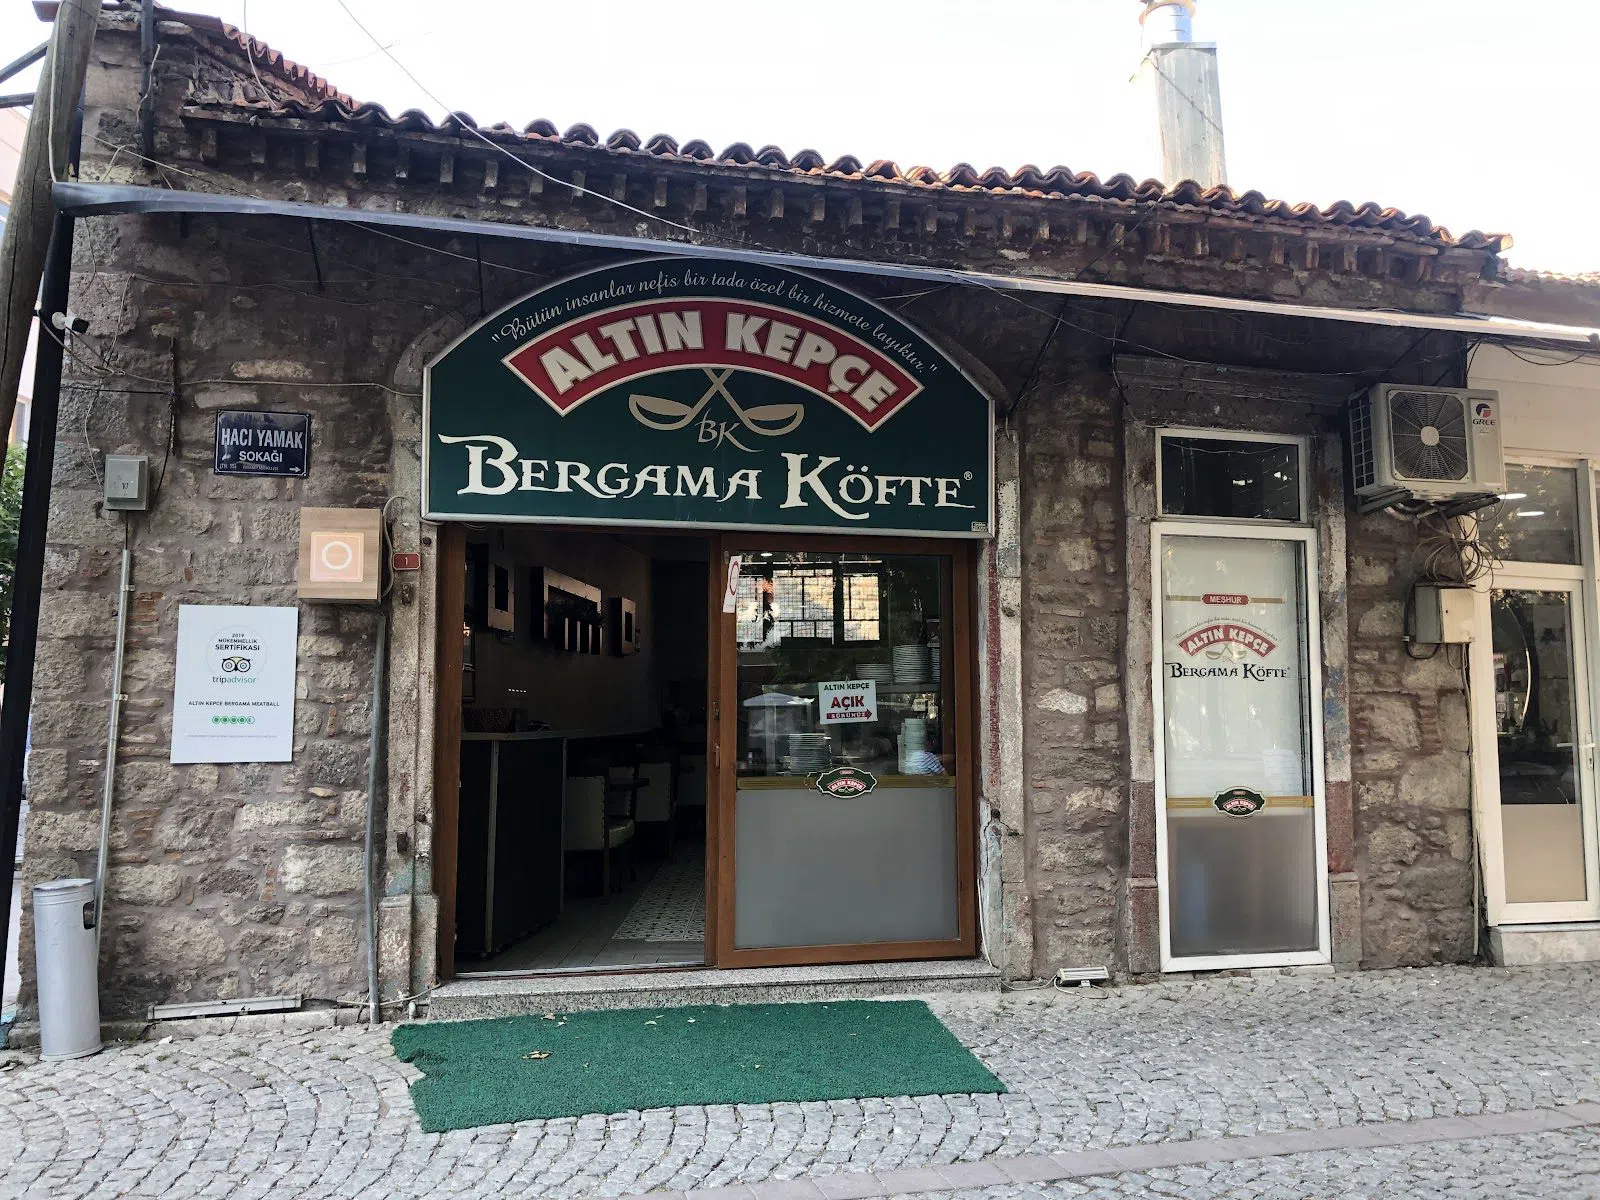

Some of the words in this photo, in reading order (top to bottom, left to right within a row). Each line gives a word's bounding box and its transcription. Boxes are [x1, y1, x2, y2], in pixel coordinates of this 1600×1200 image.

[565, 280, 636, 311] insanlar
[638, 271, 679, 294] nefis
[684, 269, 708, 286] bir
[711, 272, 748, 288] tada
[750, 277, 785, 295] özel
[788, 284, 811, 304] bir
[813, 293, 871, 331] hizmete
[539, 310, 704, 396] ALTIN
[725, 312, 899, 413] KEPÇE
[221, 428, 253, 446] HACI
[256, 429, 303, 449] YAMAK
[694, 407, 764, 452] BK
[238, 449, 283, 463] SOKAĞI
[437, 433, 763, 503] BERGAMA
[215, 643, 260, 651] SERTİFİKASI
[1186, 627, 1225, 654] ALTIN
[1228, 627, 1269, 654] KEPÇE
[212, 675, 256, 685] tripadvisor
[1165, 662, 1239, 679] BERGAMA
[823, 683, 845, 691] ALTIN
[846, 682, 870, 690] KEPÇE
[830, 695, 865, 711] AÇIK
